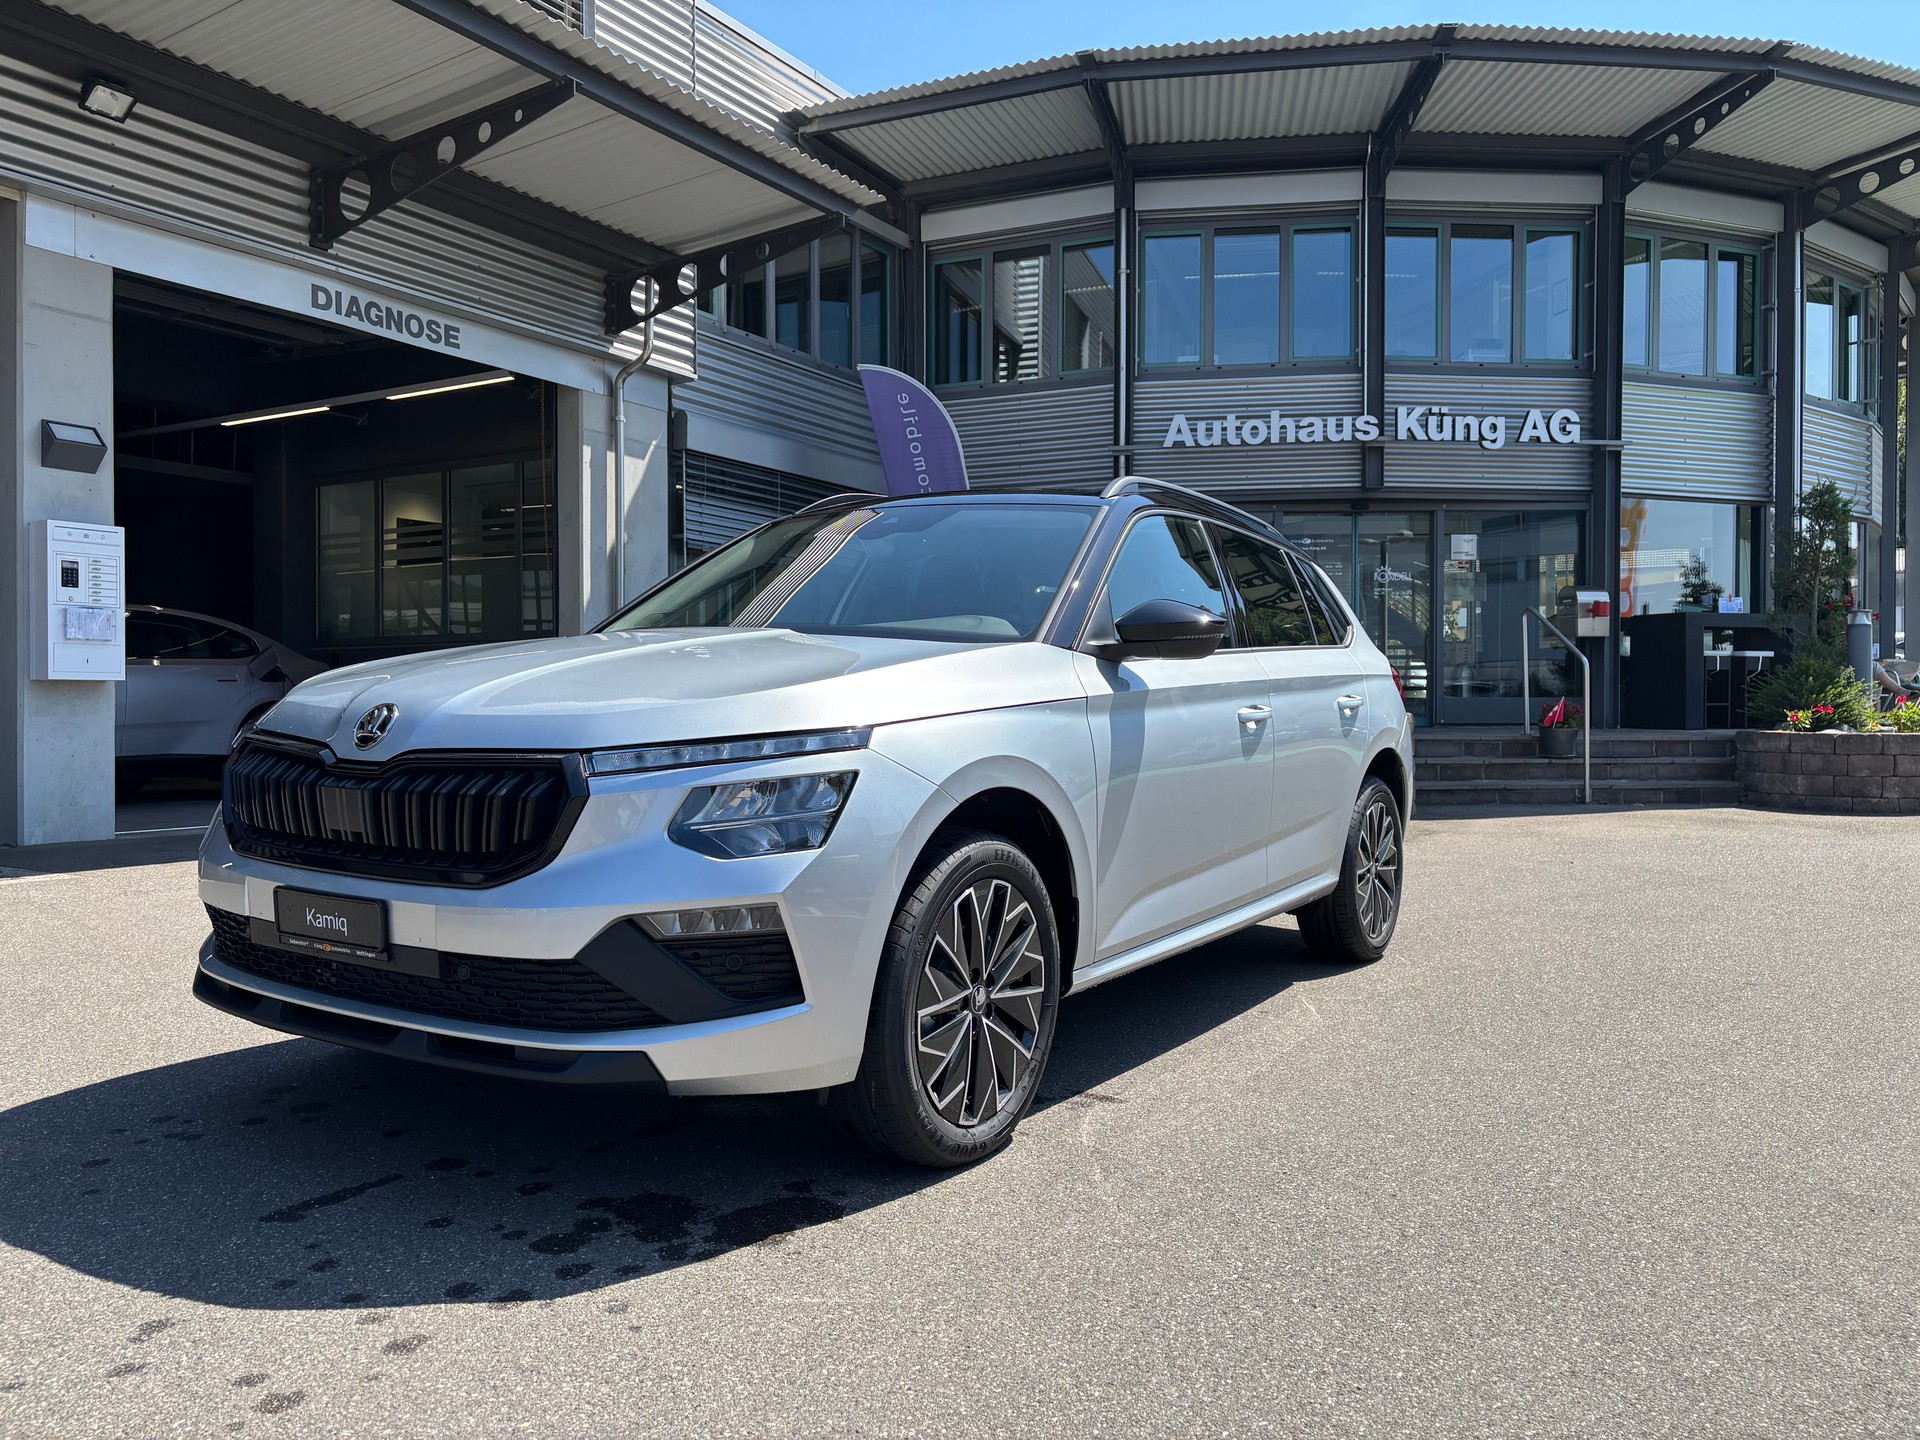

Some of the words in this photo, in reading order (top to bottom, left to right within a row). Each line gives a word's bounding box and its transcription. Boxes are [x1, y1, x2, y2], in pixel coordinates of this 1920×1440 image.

[311, 283, 460, 350] DIAGNOSE
[1163, 410, 1379, 447] Autohaus
[1397, 406, 1505, 449] Küng
[1518, 408, 1581, 444] AG
[306, 907, 347, 936] Kamiq
